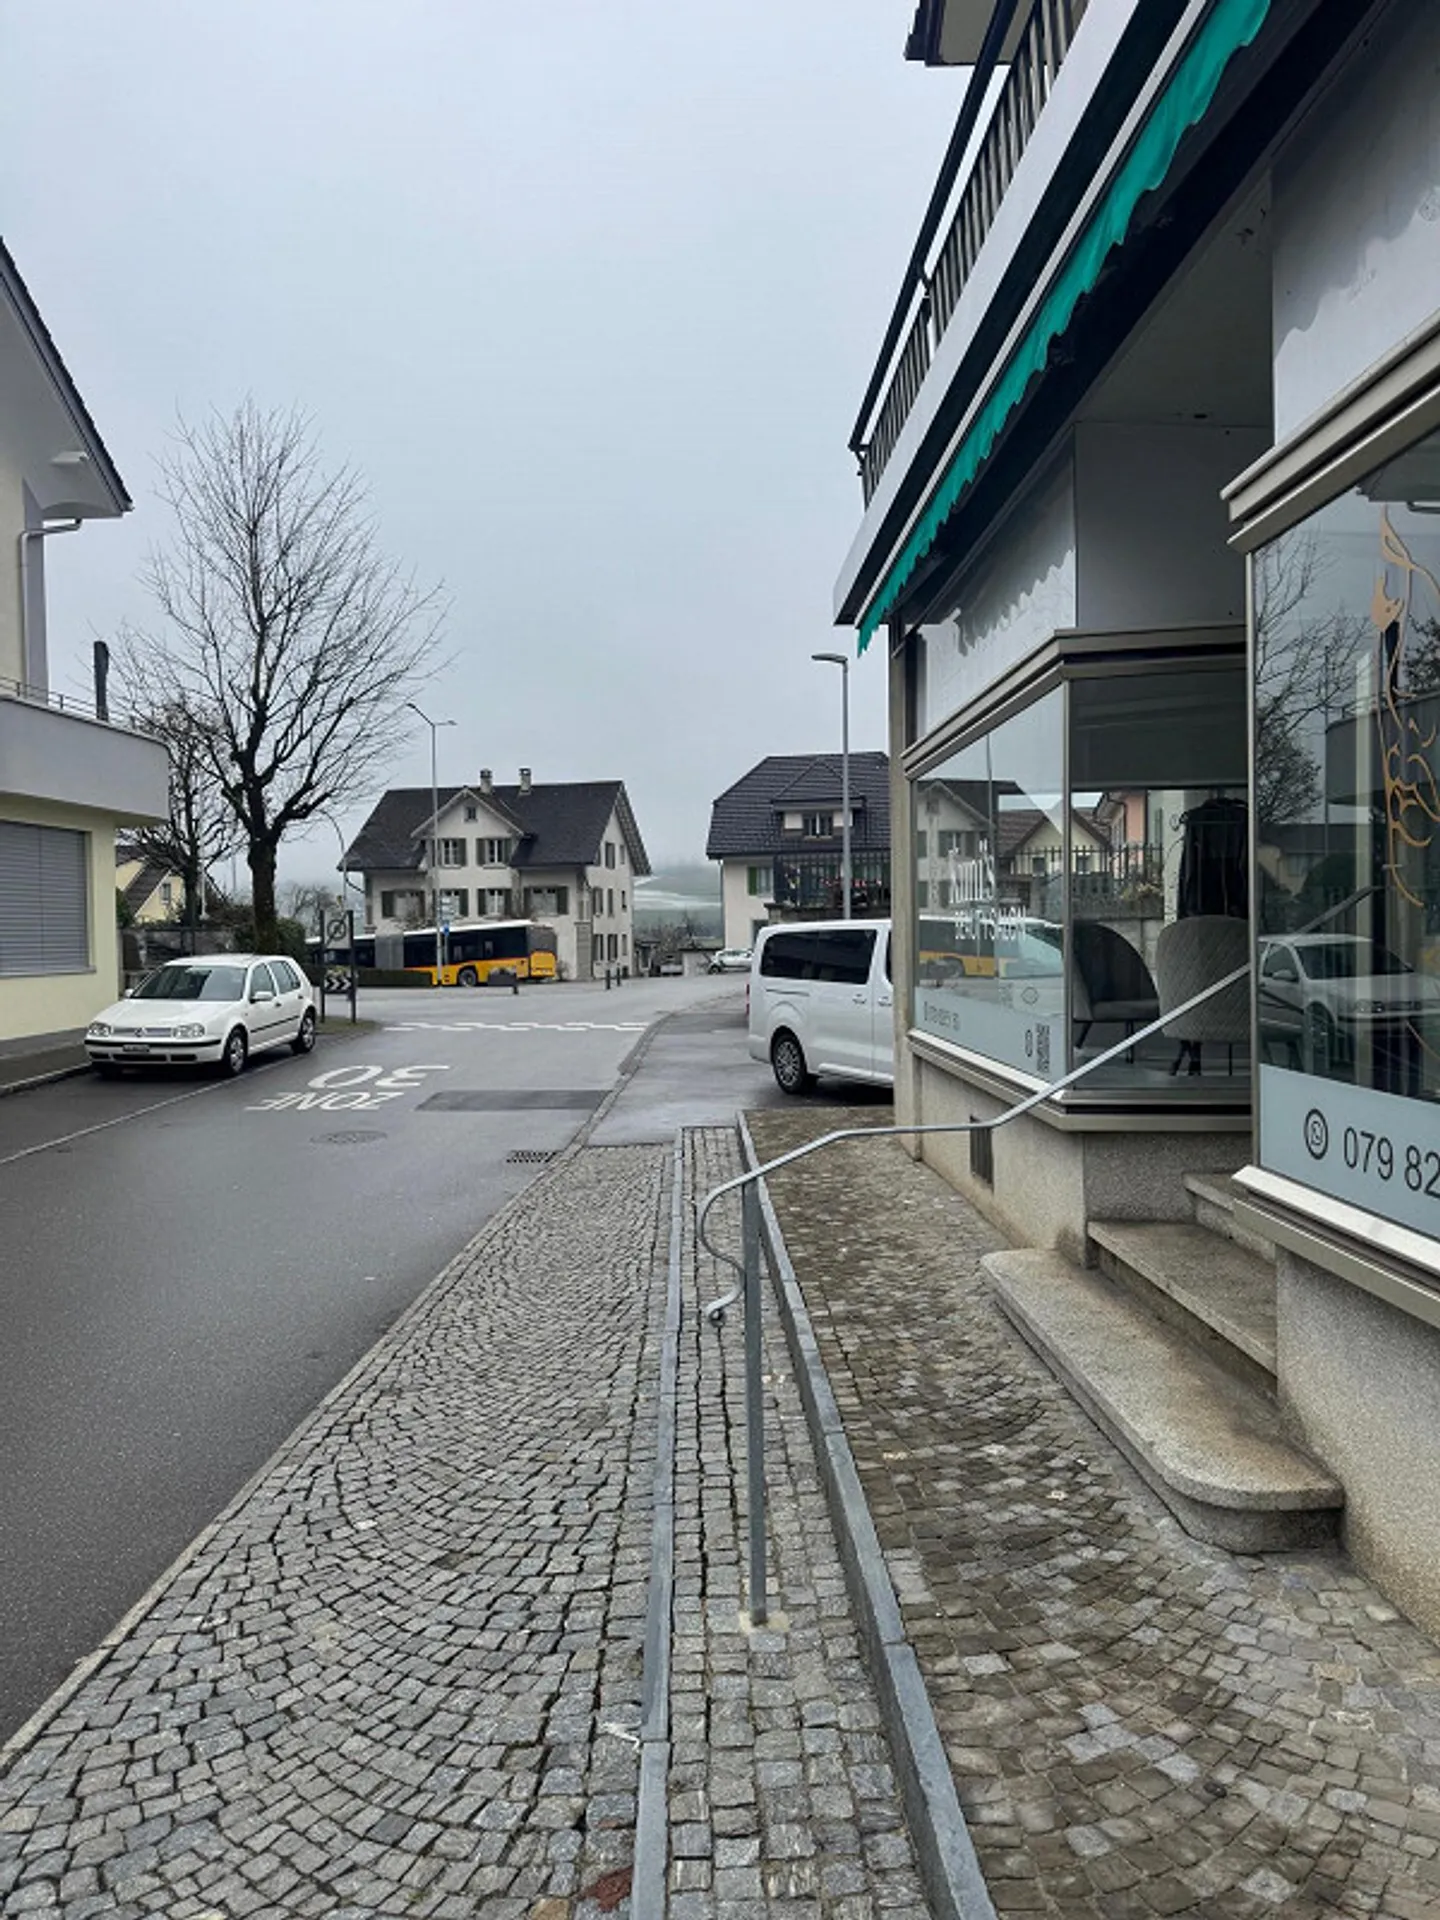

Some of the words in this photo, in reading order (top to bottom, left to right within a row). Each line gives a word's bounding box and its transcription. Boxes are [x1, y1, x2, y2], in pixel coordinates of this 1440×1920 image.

[308, 1065, 450, 1089] 30
[244, 1092, 405, 1111] ZONE
[1343, 1126, 1394, 1181] 079
